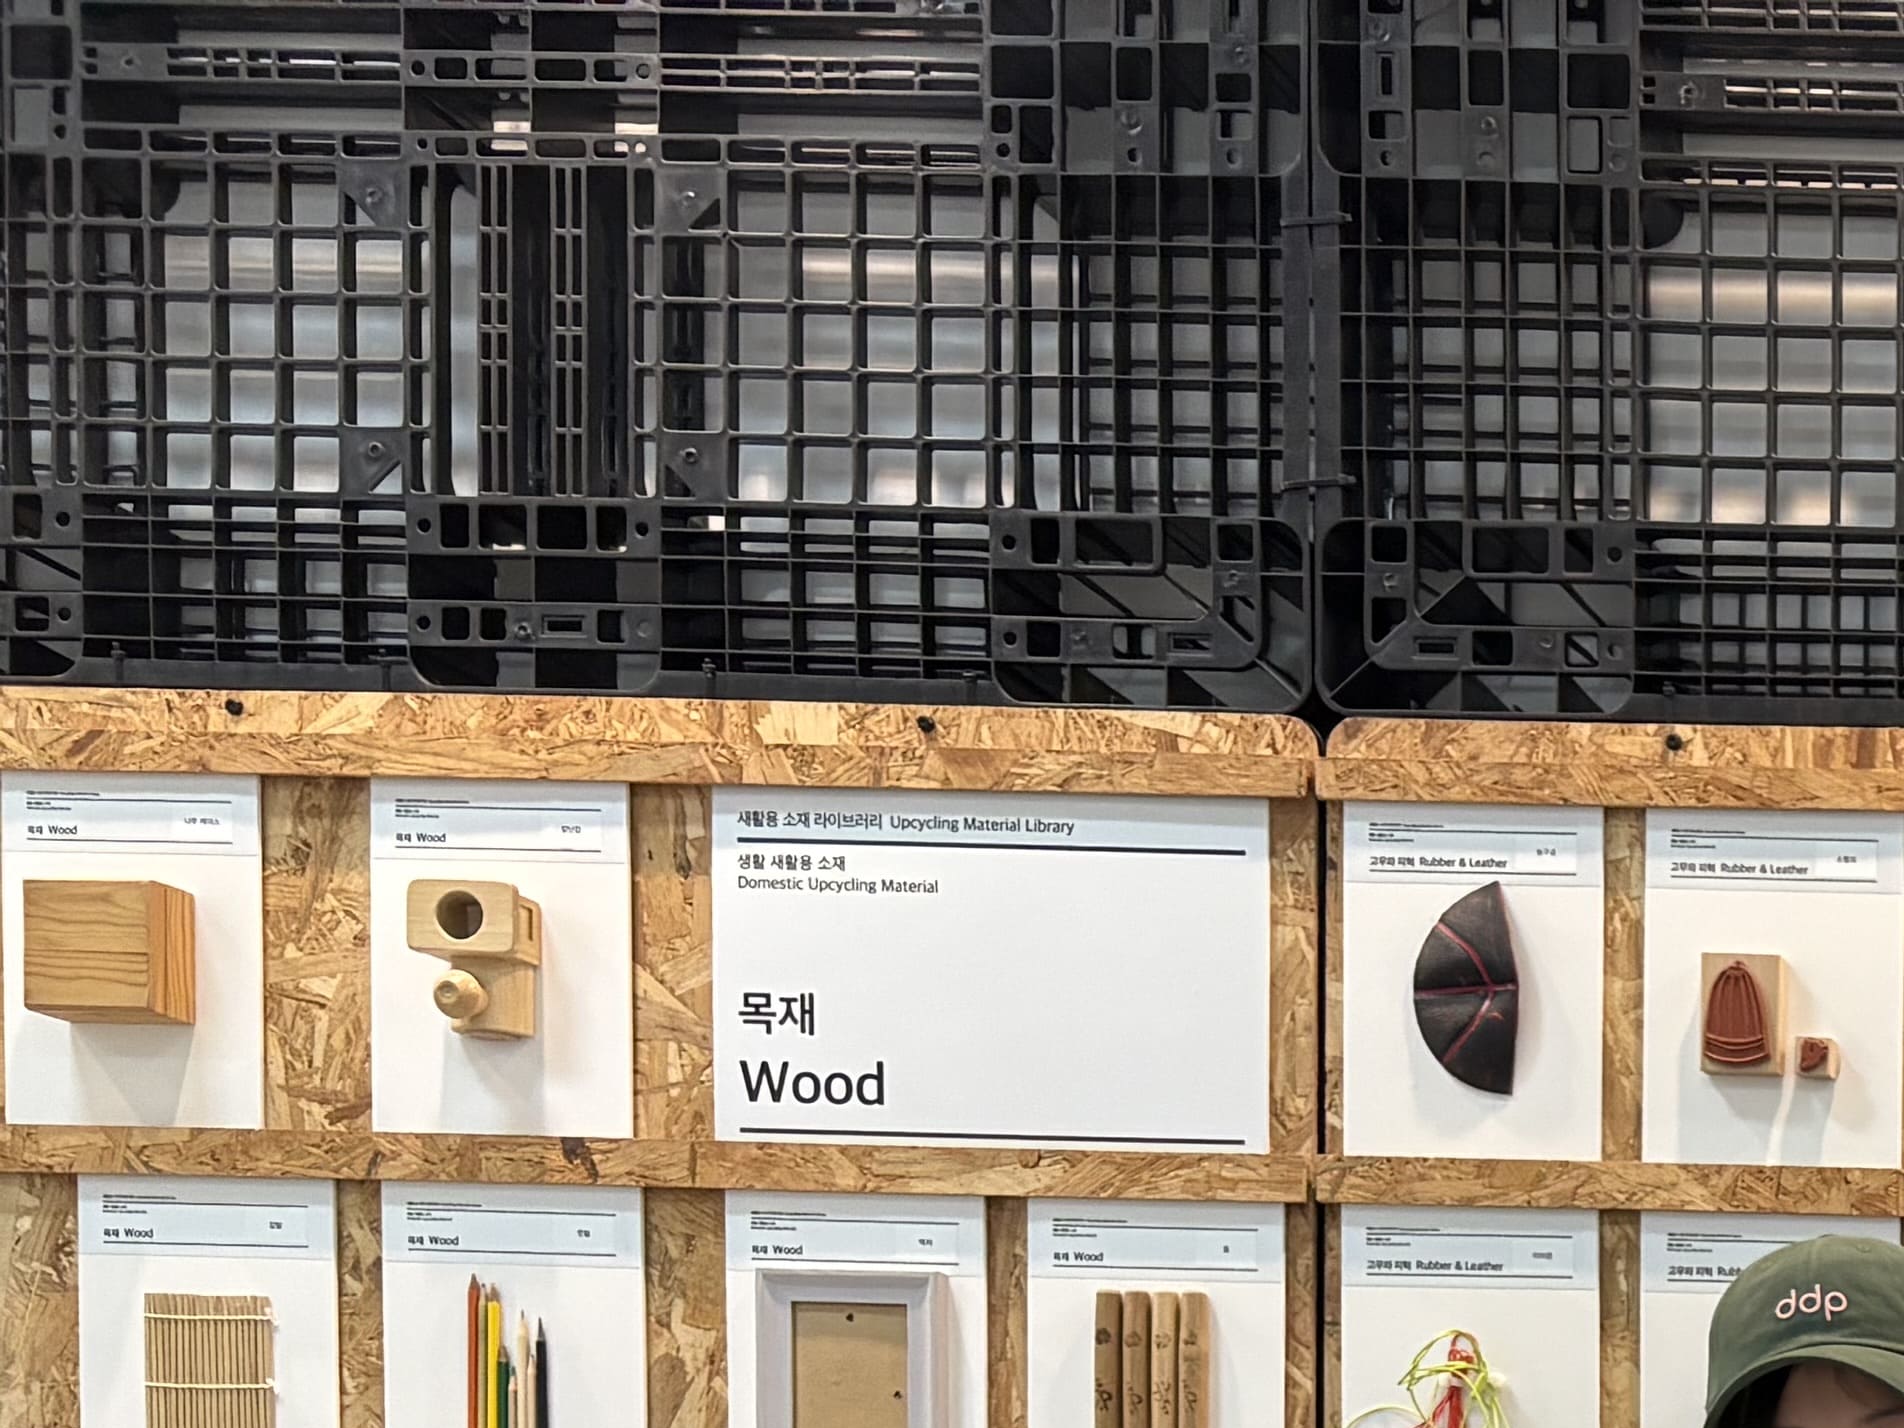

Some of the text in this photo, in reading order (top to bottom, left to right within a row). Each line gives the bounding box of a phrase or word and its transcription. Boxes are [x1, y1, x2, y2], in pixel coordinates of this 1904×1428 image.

[737, 810, 1074, 836] 새활용 소재 라이브러리 Upcycling Material Library
[48, 826, 77, 834] Wood
[416, 833, 446, 842] Wood
[738, 854, 845, 871] 생활 새활용 소재
[1419, 857, 1456, 867] Rubber
[1469, 858, 1507, 868] Leather
[1721, 863, 1756, 873] Rubber
[1770, 864, 1808, 874] Leather
[738, 876, 938, 894] Domestic Upcycling Material
[739, 993, 814, 1036] 목재
[740, 1060, 884, 1105] Wood
[124, 1228, 153, 1238] Wood
[429, 1236, 459, 1245] Wood
[773, 1245, 803, 1255] Wood
[1074, 1252, 1103, 1261] Wood
[1416, 1260, 1452, 1270] Rubber
[1465, 1261, 1503, 1271] Leather
[1775, 1284, 1848, 1321] ddp
